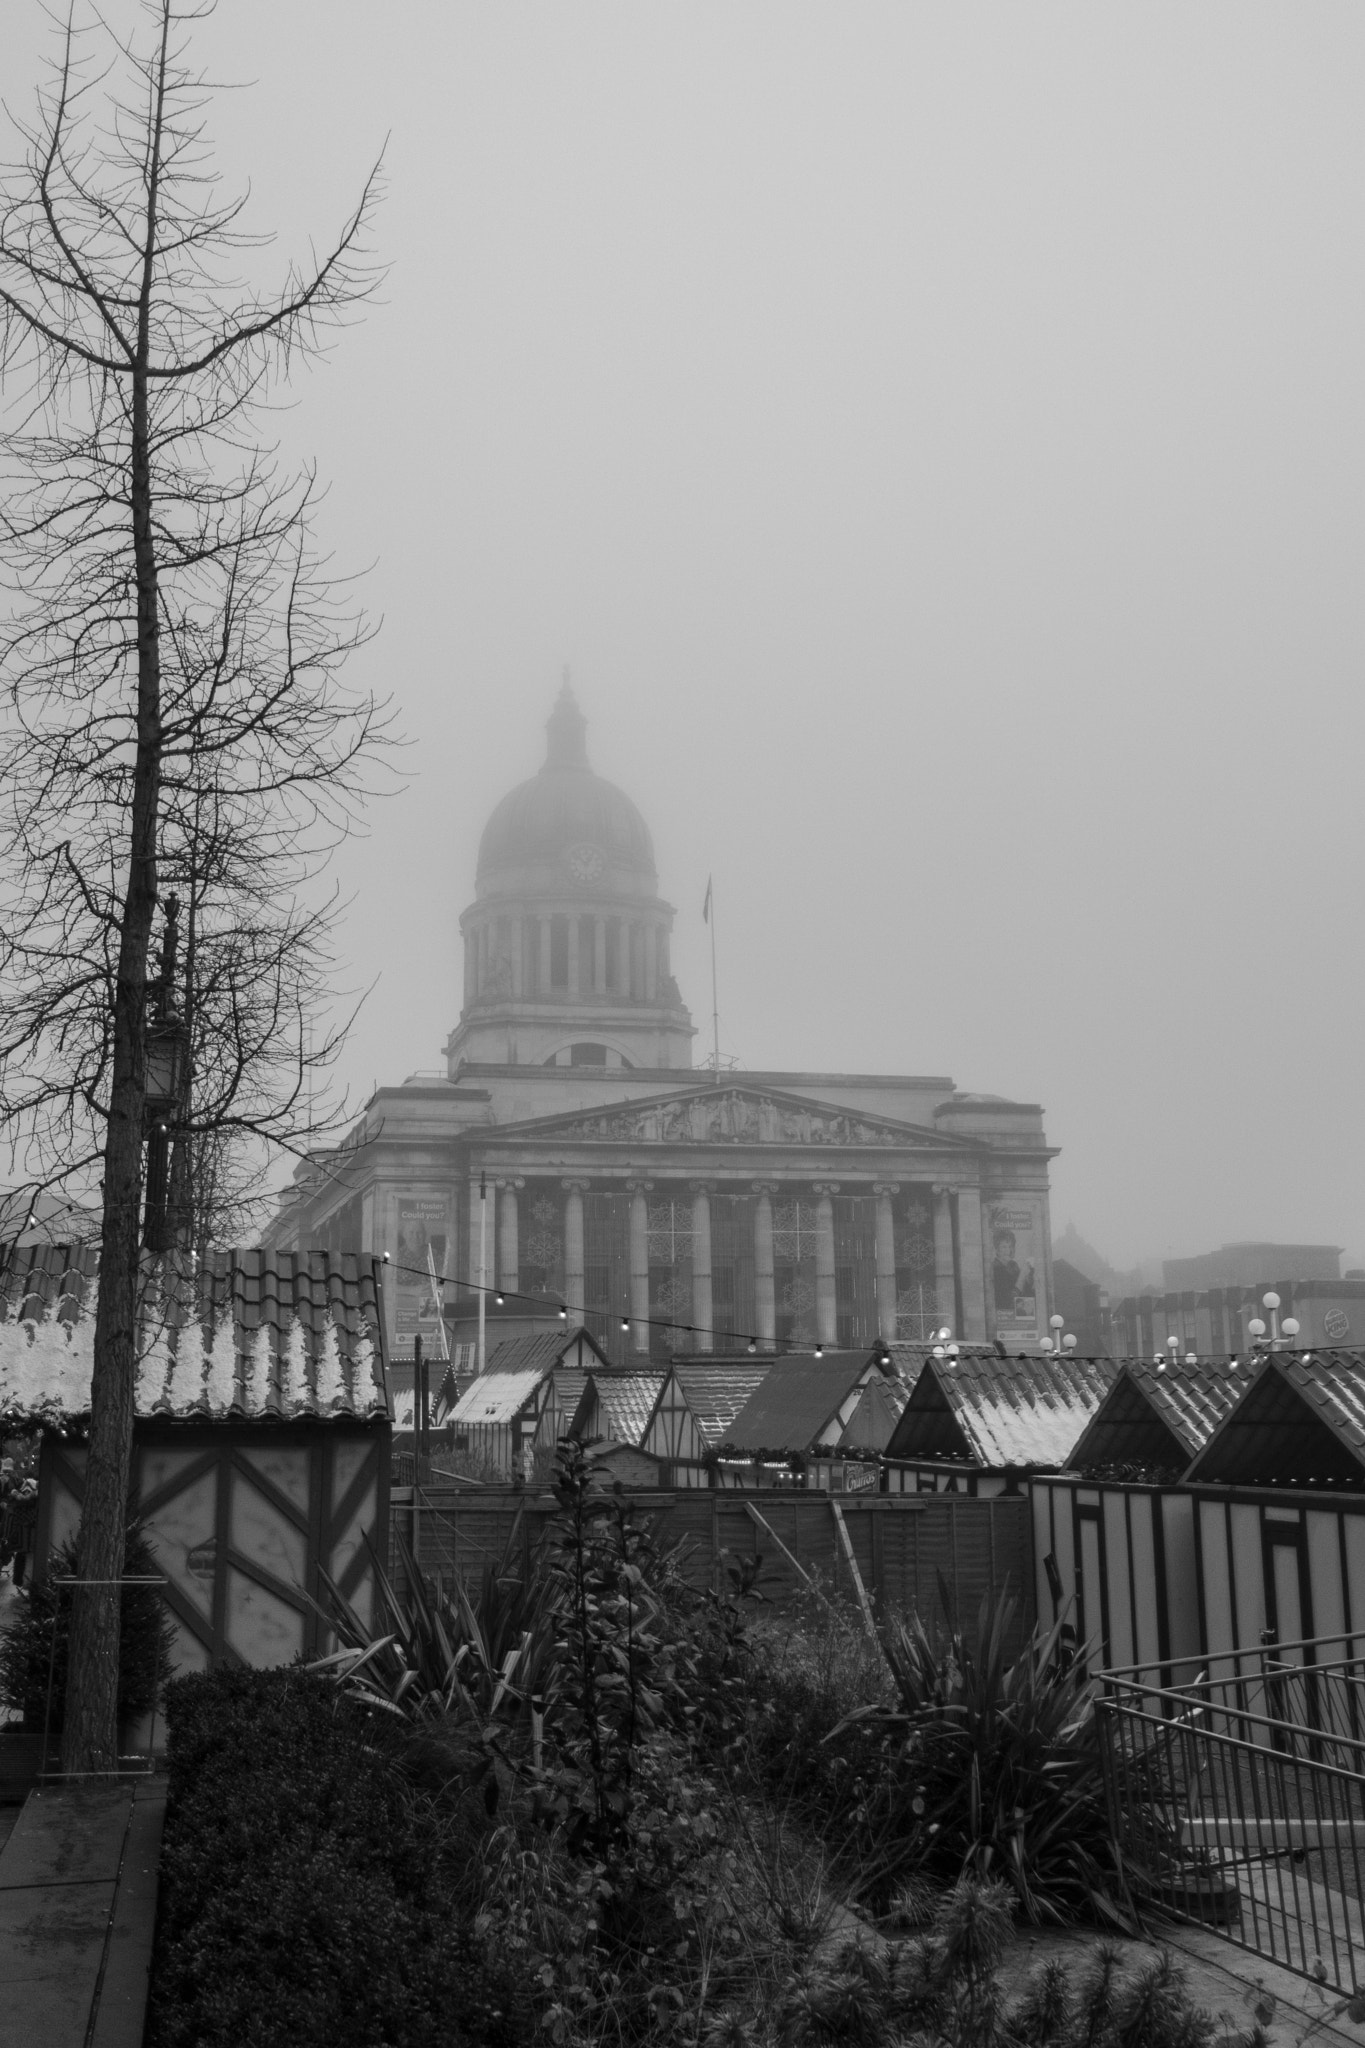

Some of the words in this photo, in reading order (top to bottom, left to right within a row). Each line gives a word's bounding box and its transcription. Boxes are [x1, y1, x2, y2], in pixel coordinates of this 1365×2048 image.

[401, 1211, 425, 1219] Could
[426, 1212, 445, 1220] you?
[1327, 1319, 1347, 1334] KING
[846, 1473, 876, 1492] Churros
